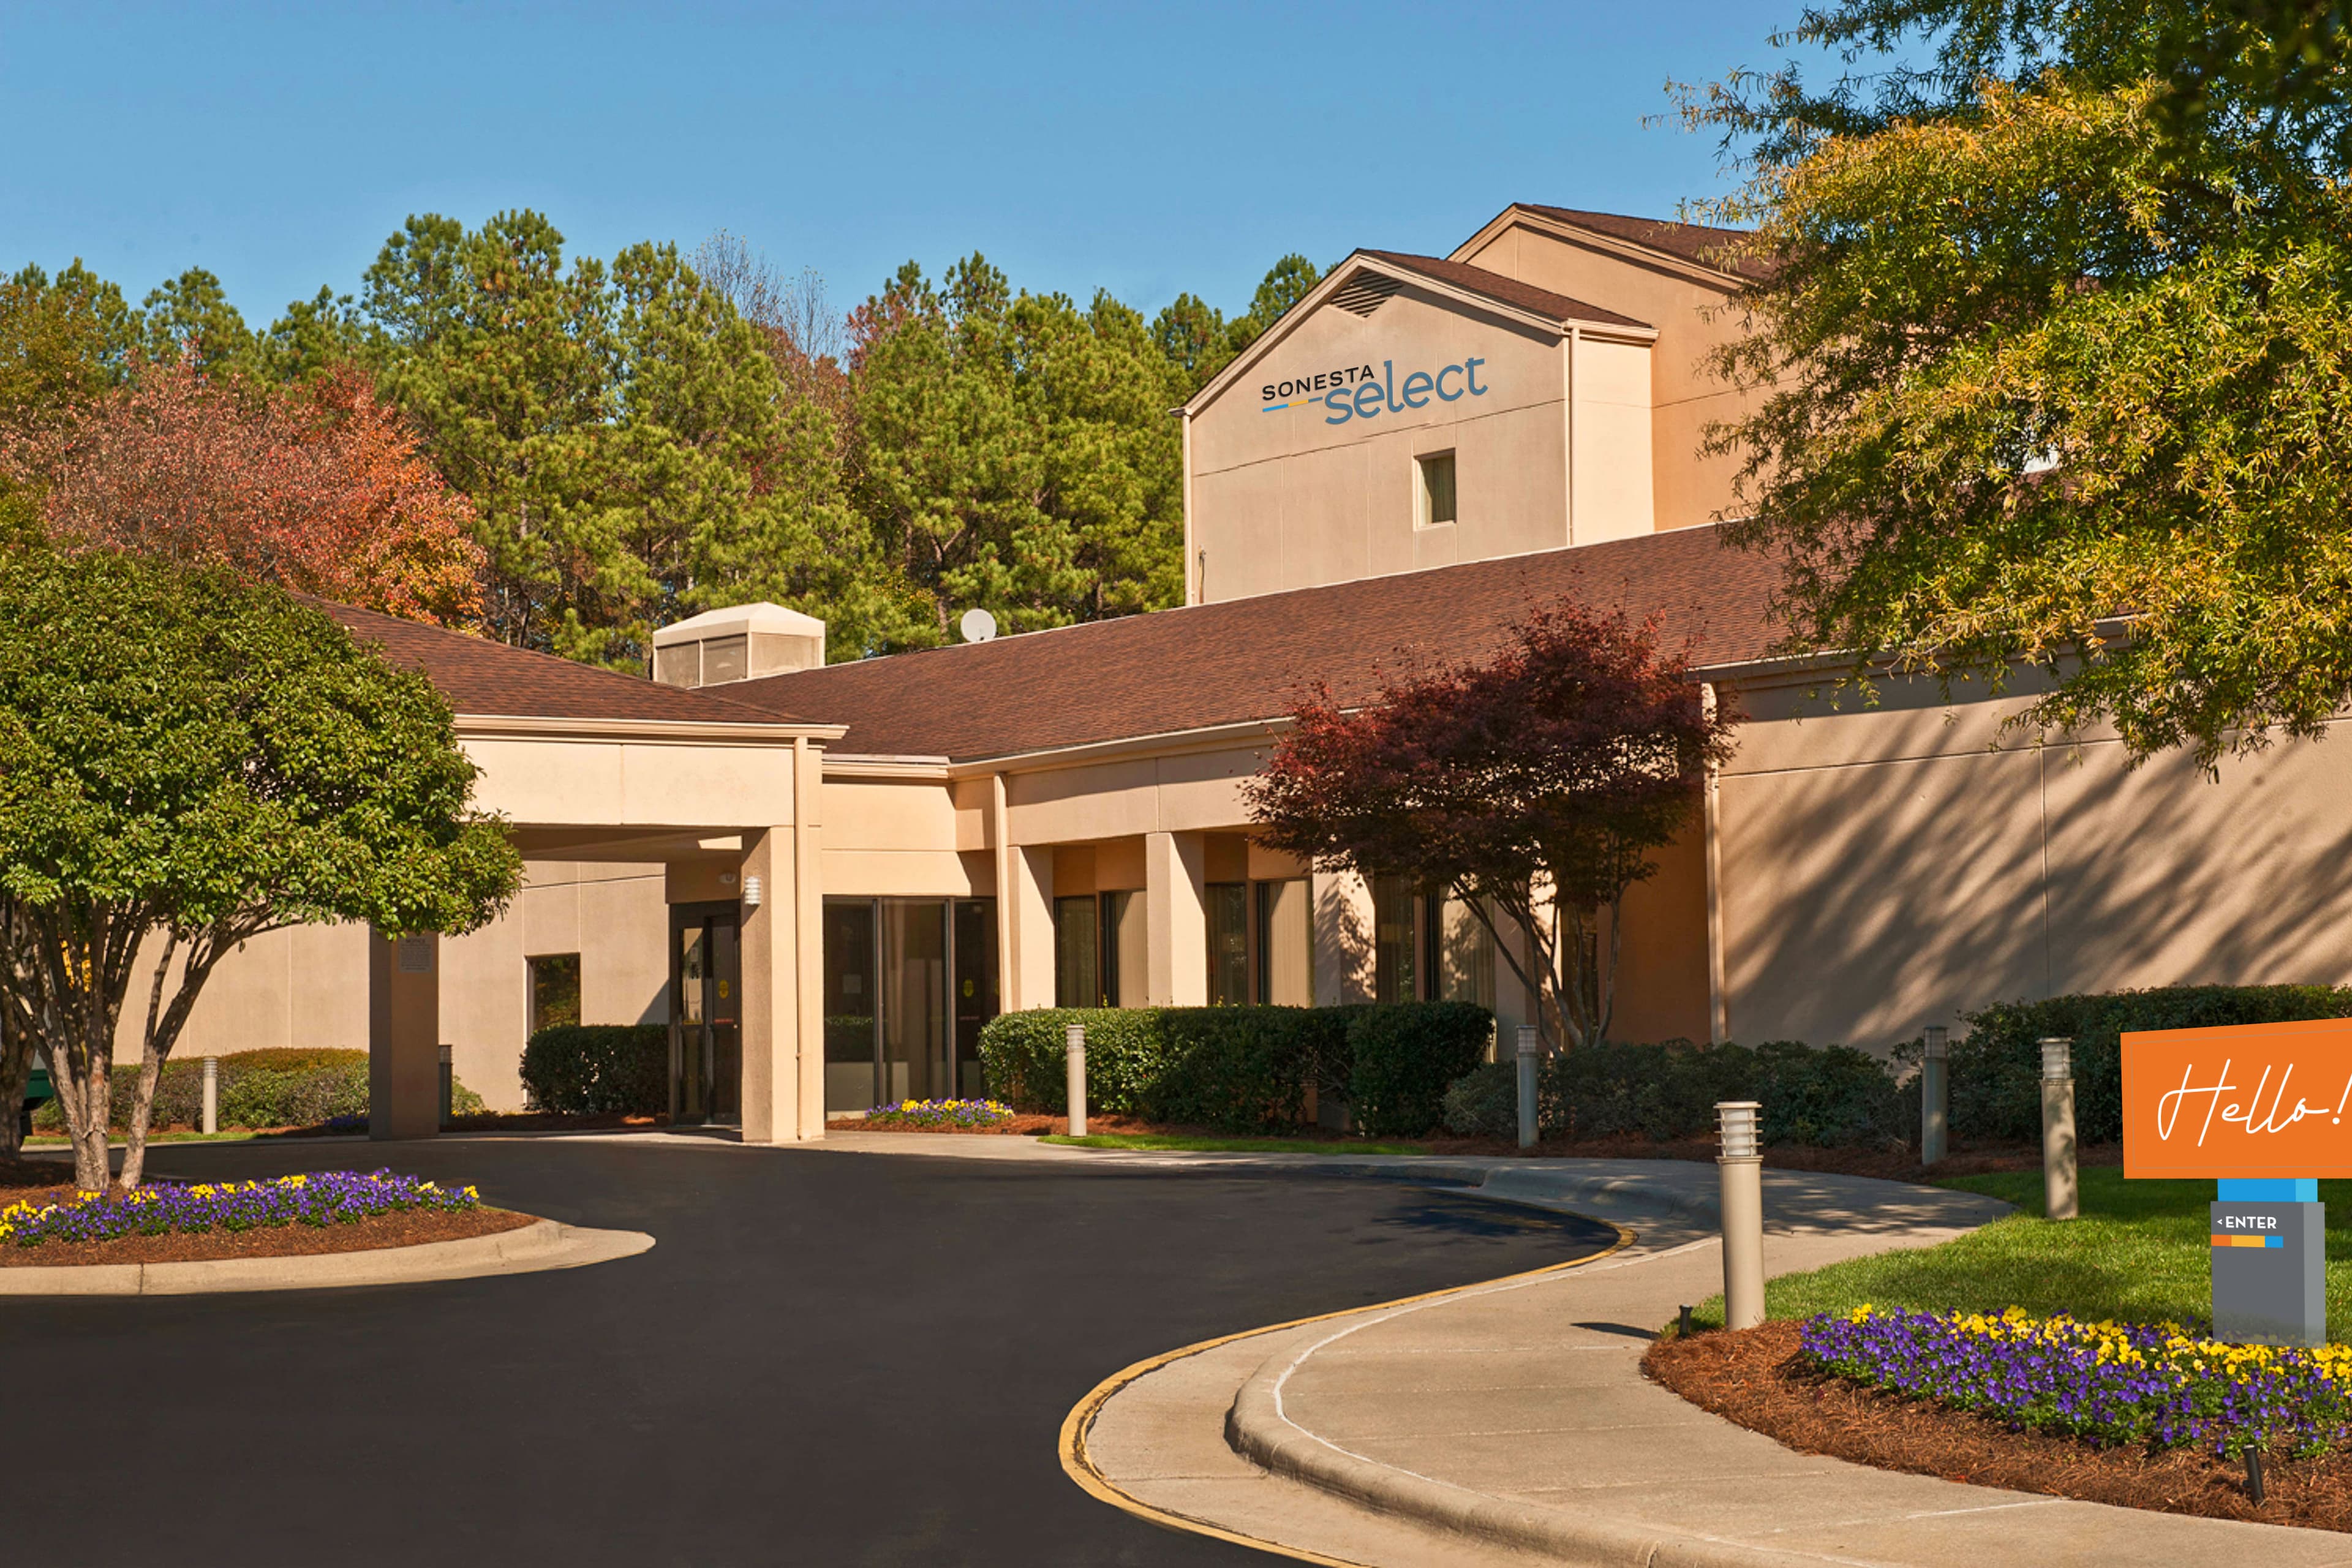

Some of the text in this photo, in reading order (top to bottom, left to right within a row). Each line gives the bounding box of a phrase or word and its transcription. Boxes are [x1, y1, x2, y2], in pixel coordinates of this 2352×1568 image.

[1262, 364, 1374, 401] SONESTA
[1325, 358, 1488, 424] select
[2157, 1058, 2352, 1147] Hello!
[2225, 1216, 2277, 1229] ENTER
